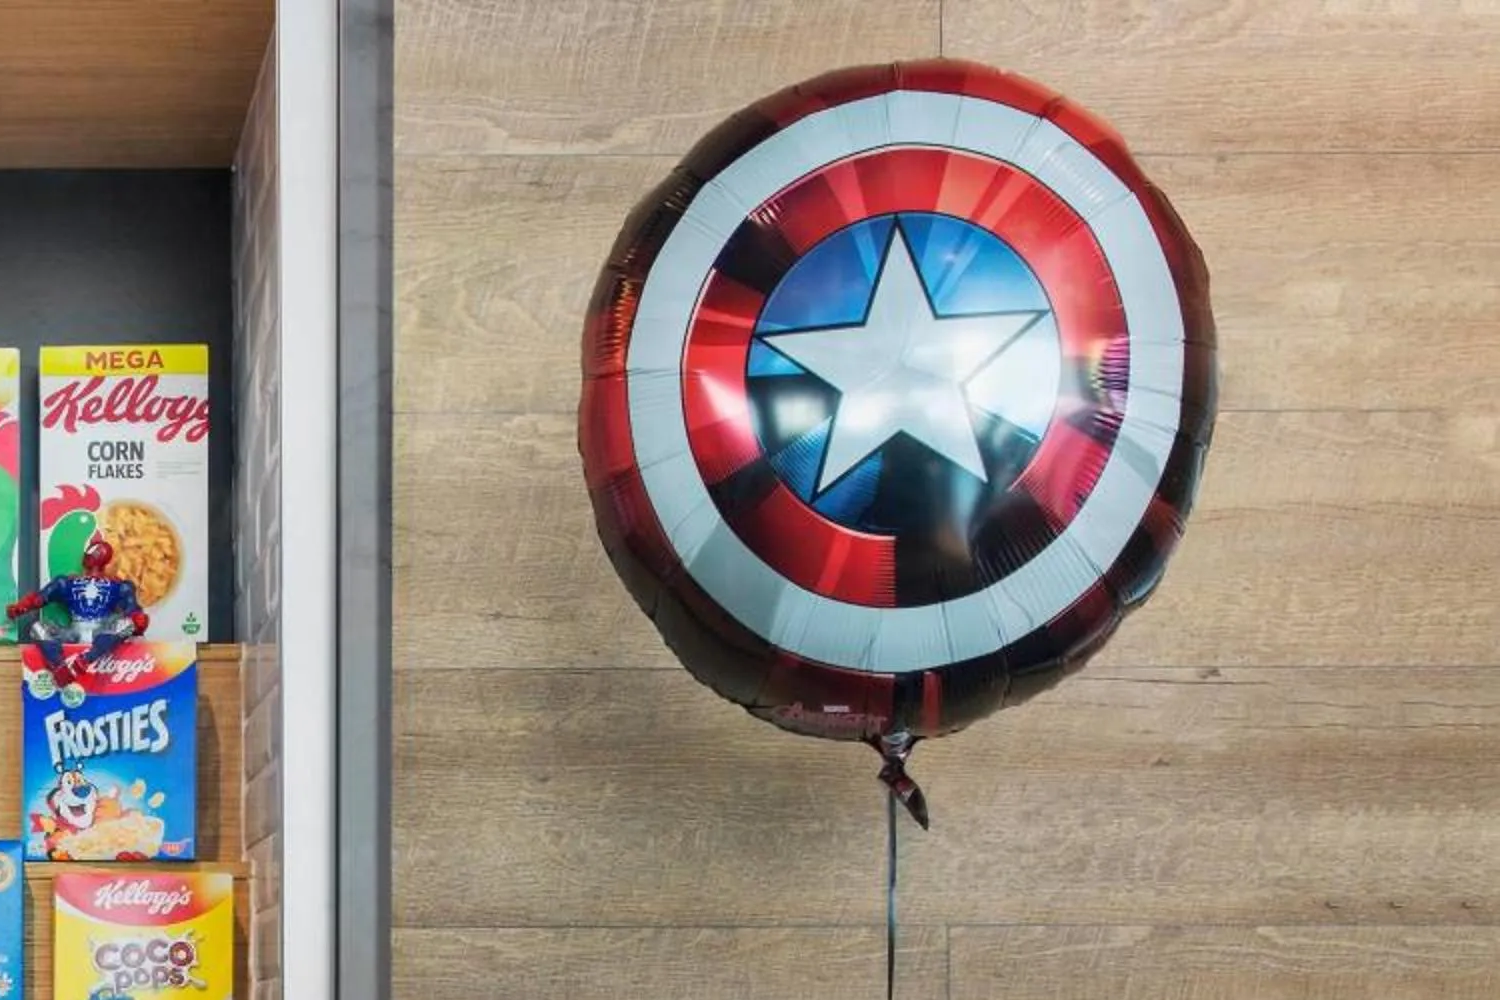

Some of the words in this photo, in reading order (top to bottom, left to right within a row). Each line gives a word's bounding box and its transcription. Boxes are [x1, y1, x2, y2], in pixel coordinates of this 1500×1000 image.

[85, 350, 164, 371] MEGA
[86, 440, 145, 463] CORN
[88, 463, 145, 480] FLAKES
[45, 699, 169, 763] FROSTIES
[93, 879, 193, 914] Kellogg's
